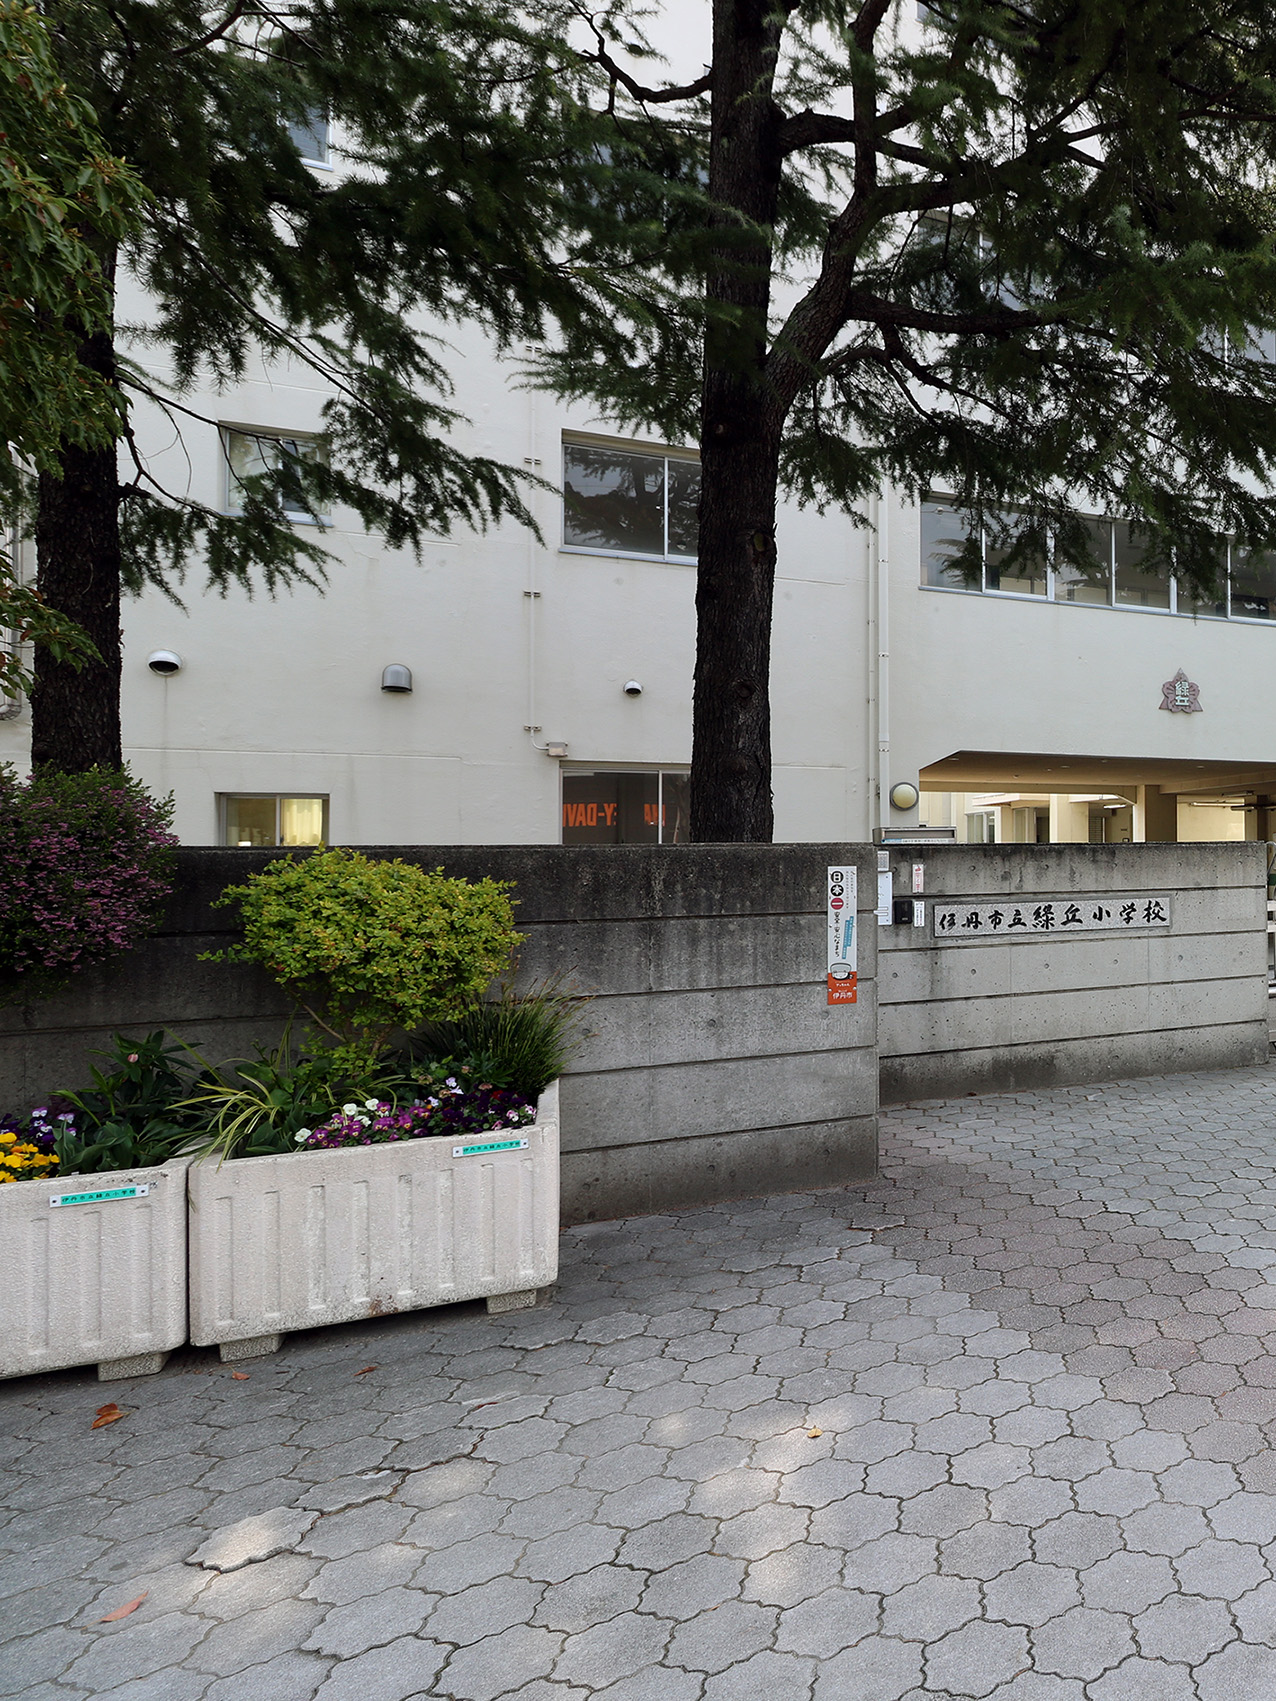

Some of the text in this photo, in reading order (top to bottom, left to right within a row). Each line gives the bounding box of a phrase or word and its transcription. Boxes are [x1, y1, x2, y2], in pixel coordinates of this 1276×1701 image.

[938, 899, 1168, 932] 伊丹市立緑丘小学校
